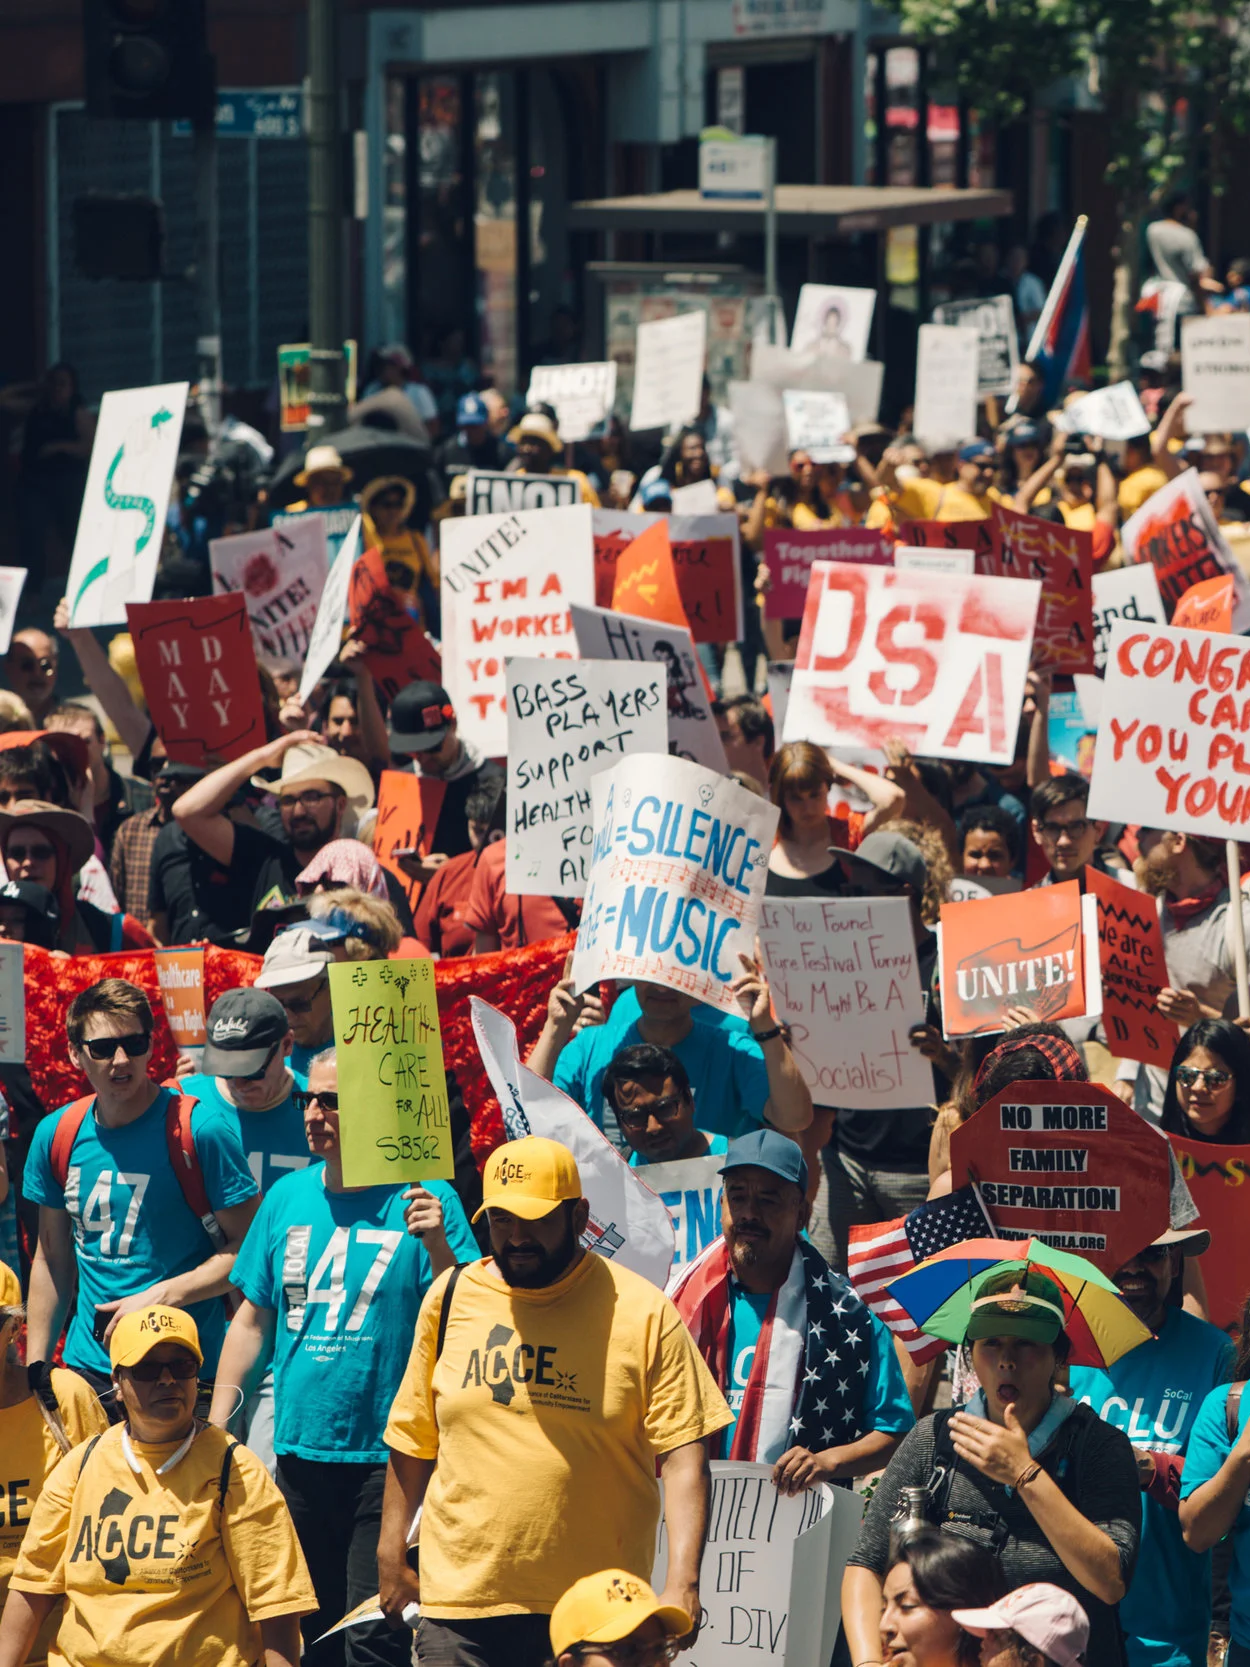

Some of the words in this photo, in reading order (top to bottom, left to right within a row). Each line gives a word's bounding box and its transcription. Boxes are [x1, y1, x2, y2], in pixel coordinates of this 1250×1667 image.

[444, 516, 529, 594] UNITE!
[776, 541, 877, 563] Together
[540, 573, 562, 597] A
[466, 657, 505, 682] YO
[794, 569, 1009, 754] DSA
[513, 674, 587, 720] BASS
[546, 683, 660, 739] PLAYERS
[1110, 717, 1188, 764] YOU
[562, 825, 593, 852] FO
[627, 796, 761, 895] SILENCE
[560, 856, 589, 885] AL
[615, 884, 741, 983] MUSIC
[760, 903, 779, 929] If
[784, 904, 813, 934] You
[821, 902, 874, 933] Found
[764, 941, 798, 979] Fyre
[800, 941, 863, 974] Festival
[868, 934, 913, 980] Funny
[1109, 952, 1153, 980] ALL
[1120, 933, 1154, 967] are
[956, 949, 1077, 1002] UNITE!
[774, 981, 804, 1015] You
[855, 979, 878, 1016] Be
[884, 978, 905, 1012] A
[378, 1051, 431, 1089] CARE
[788, 1023, 910, 1094] Socialist
[395, 1098, 413, 1114] FOR
[1001, 1105, 1033, 1131] NO
[1041, 1105, 1107, 1131] MORE
[375, 1135, 441, 1162] SB562
[1009, 1148, 1088, 1173] FAMILY
[981, 1181, 1118, 1211] SEPARATION
[306, 1225, 404, 1332] 47
[305, 1343, 316, 1352] Los
[317, 1343, 347, 1354] Angeles
[461, 1343, 558, 1390] ACCE
[1163, 1387, 1193, 1402] SoCal
[69, 1514, 181, 1563] ACCE
[716, 1550, 756, 1594] OF
